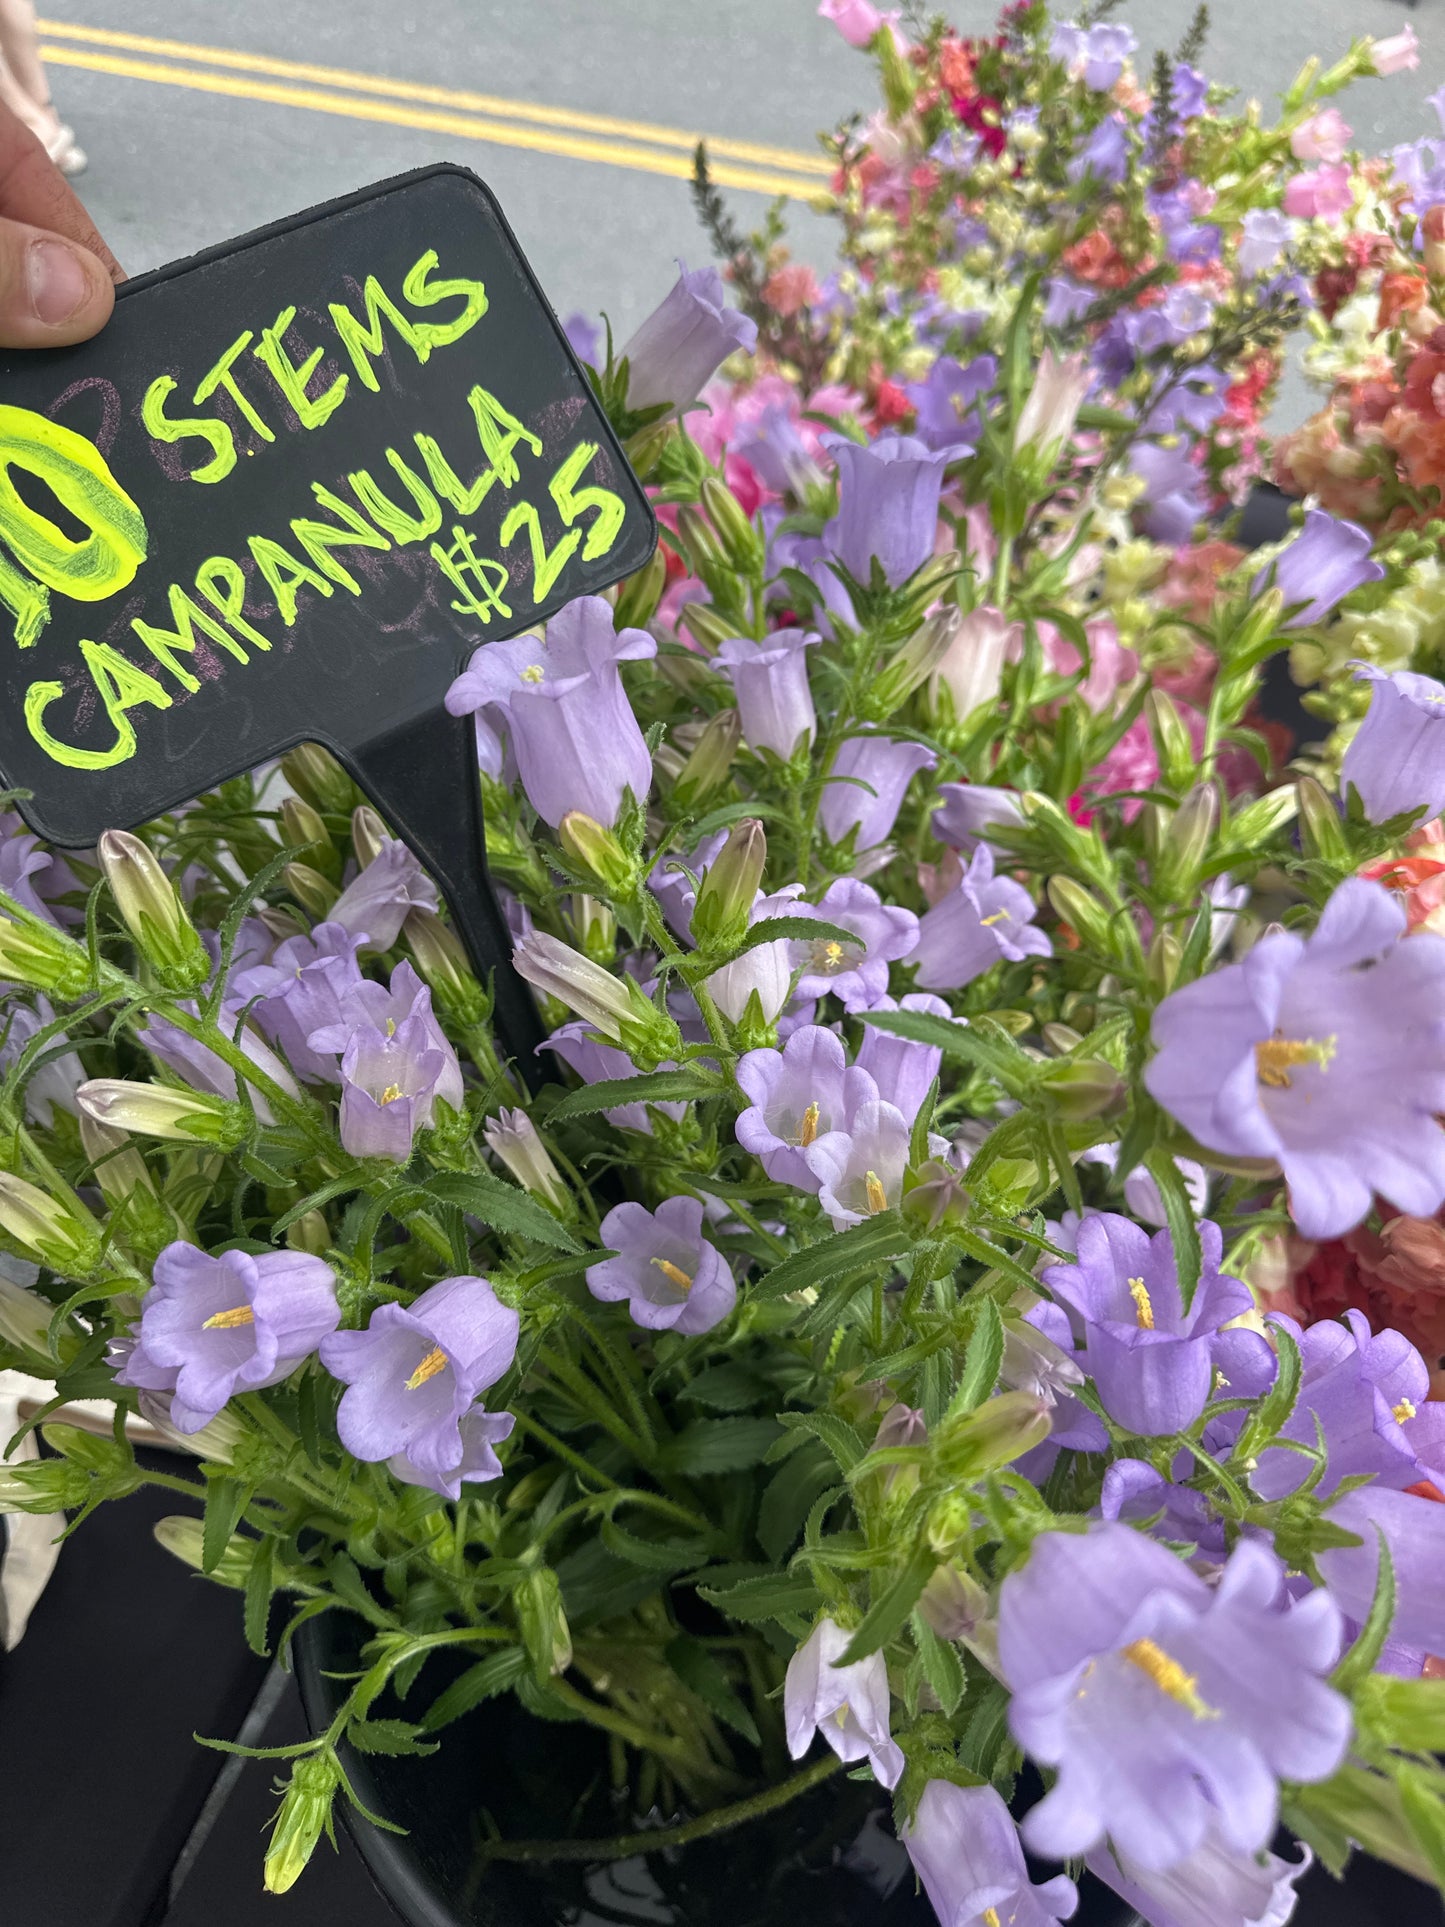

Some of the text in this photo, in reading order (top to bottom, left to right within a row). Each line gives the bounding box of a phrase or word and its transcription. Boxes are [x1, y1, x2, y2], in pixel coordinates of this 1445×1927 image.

[141, 249, 489, 485] STEMS
[24, 384, 543, 771] CAMPANULA
[430, 442, 626, 624] $25
